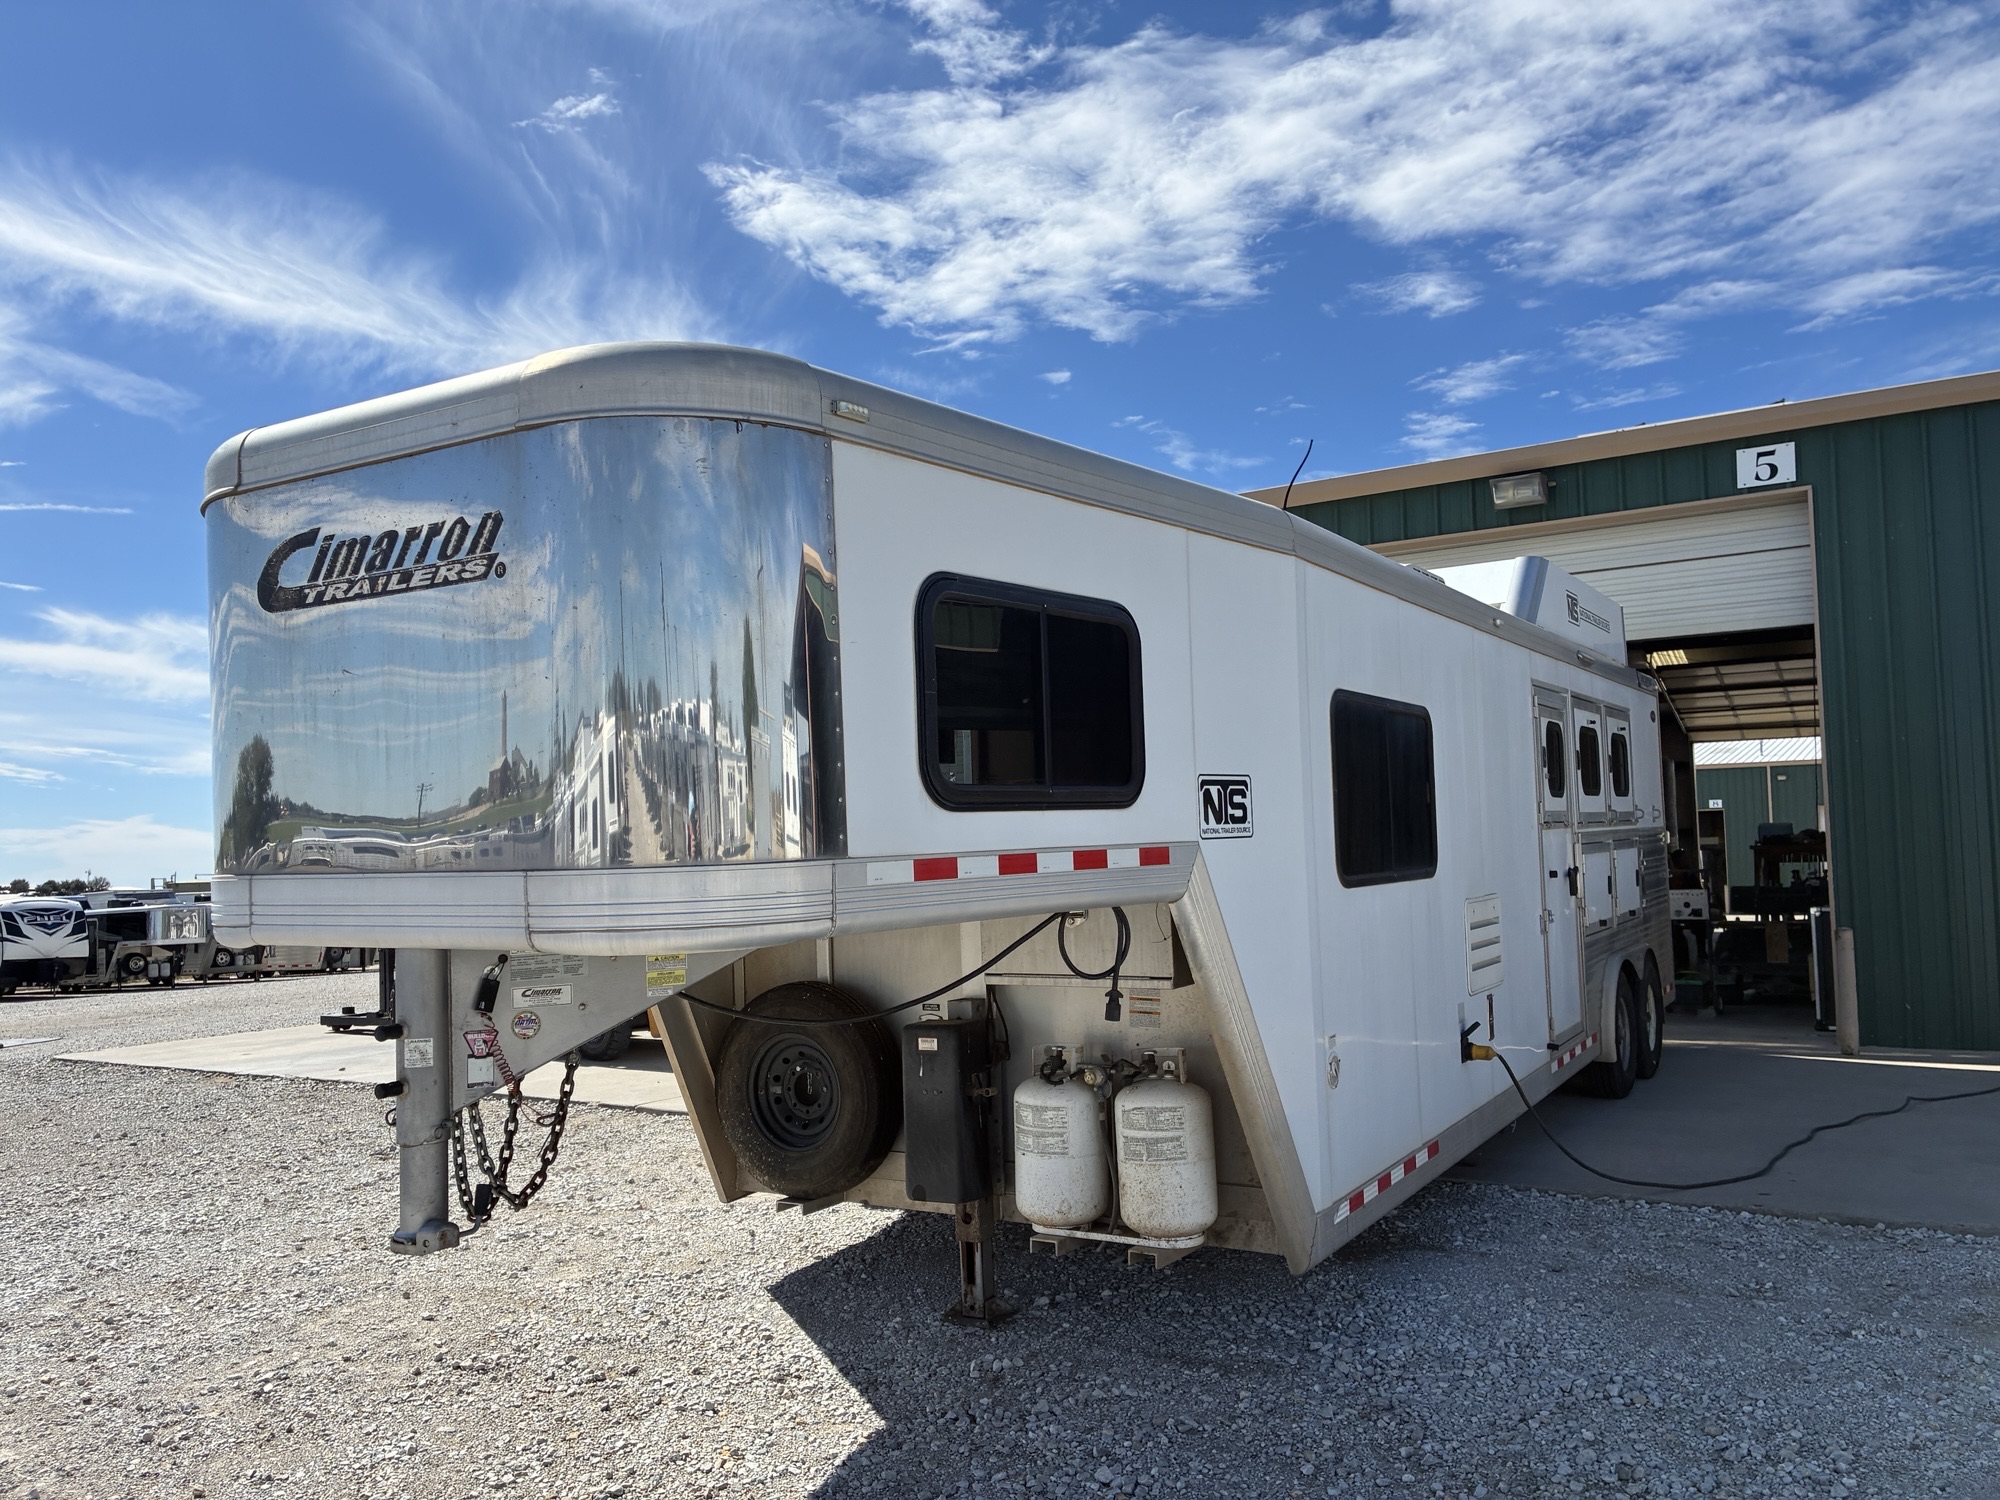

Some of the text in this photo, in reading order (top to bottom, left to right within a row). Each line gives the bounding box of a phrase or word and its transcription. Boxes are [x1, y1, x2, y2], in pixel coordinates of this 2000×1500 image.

[1755, 448, 1779, 482] 5
[257, 510, 504, 613] Cimarron
[304, 559, 489, 604] TRAILERS
[1200, 780, 1249, 826] NTS
[1202, 827, 1221, 835] NATIONAL
